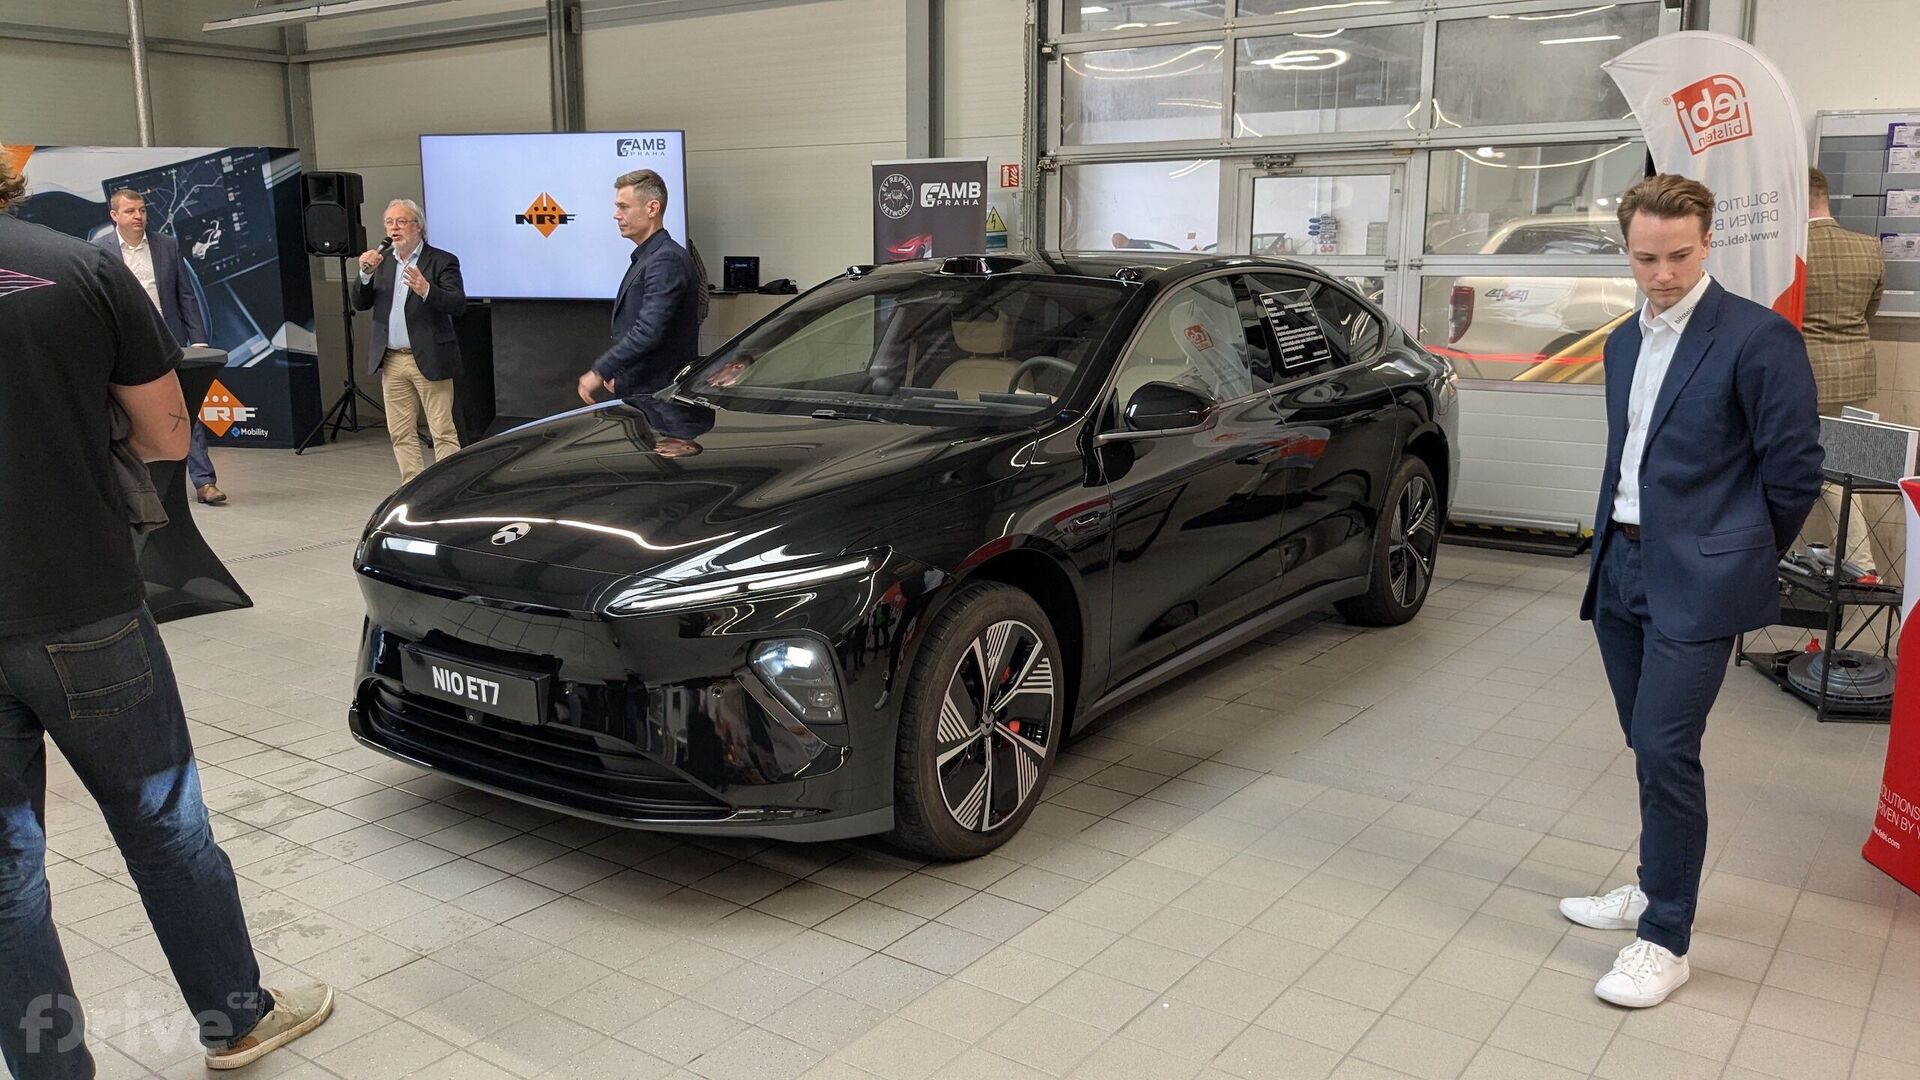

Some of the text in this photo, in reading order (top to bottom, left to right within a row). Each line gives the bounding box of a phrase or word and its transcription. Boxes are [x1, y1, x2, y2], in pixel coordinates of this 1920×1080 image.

[631, 138, 667, 151] AMB
[881, 176, 912, 193] EV REPAIR
[937, 181, 981, 199] AMB
[881, 203, 911, 216] NETWORK
[515, 214, 576, 225] NRF
[198, 406, 258, 422] RF
[240, 427, 269, 438] Mobility
[432, 665, 500, 706] NIO ET7
[1900, 816, 1915, 835] BY
